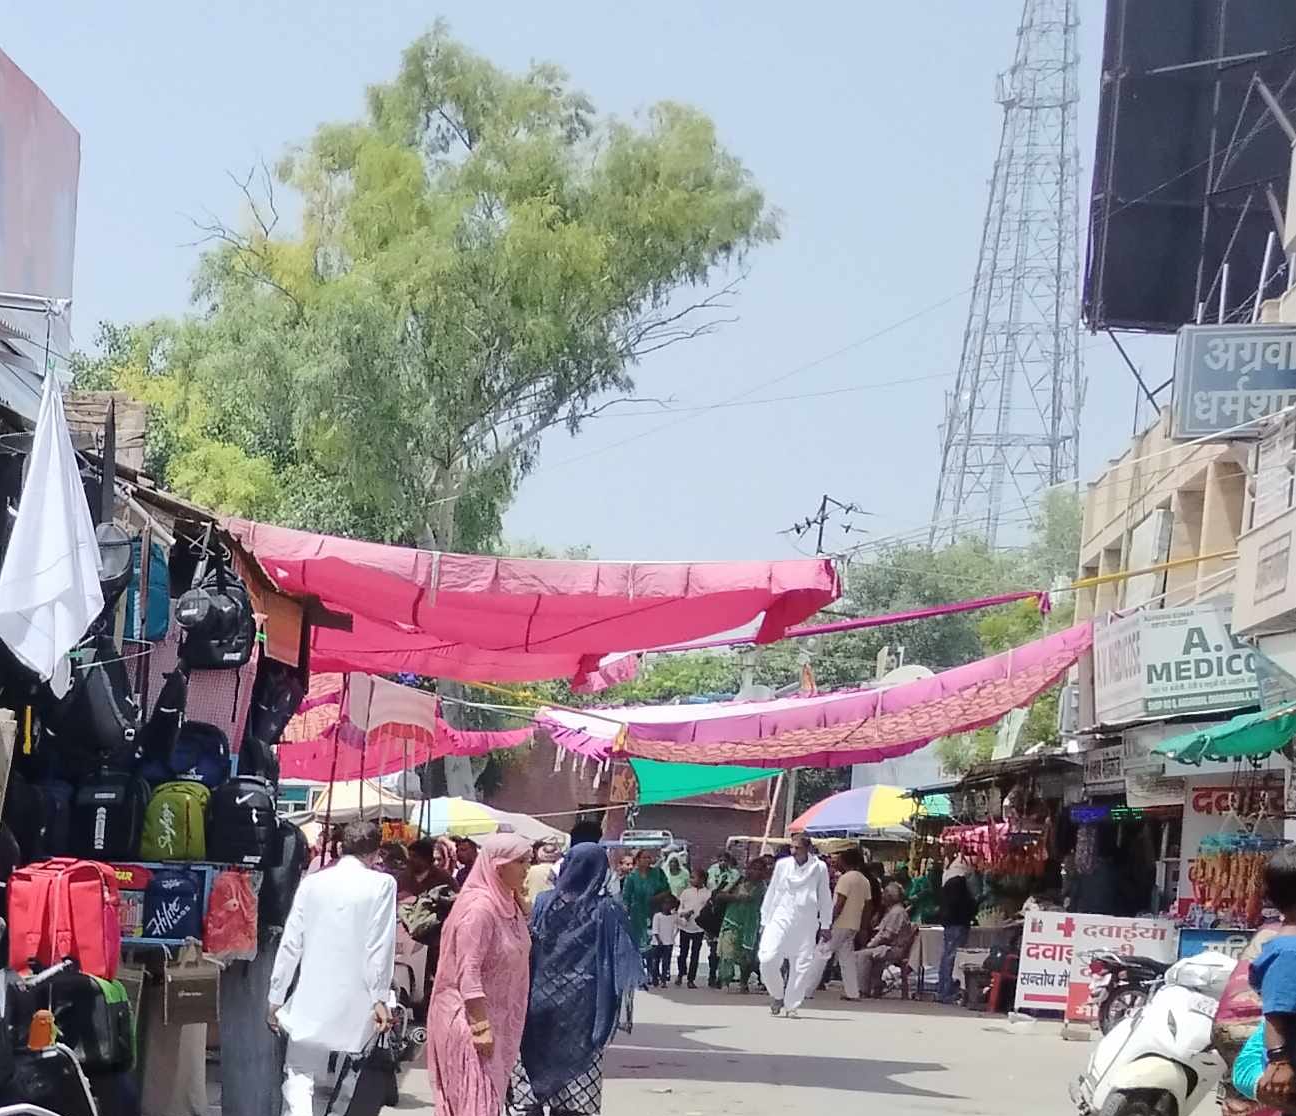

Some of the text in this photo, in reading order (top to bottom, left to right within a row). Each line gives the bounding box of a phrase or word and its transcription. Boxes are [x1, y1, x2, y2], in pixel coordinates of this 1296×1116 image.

[1204, 336, 1296, 374] अग्रवा
[1194, 376, 1296, 424] धर्मशा
[1146, 652, 1257, 685] MEDICO
